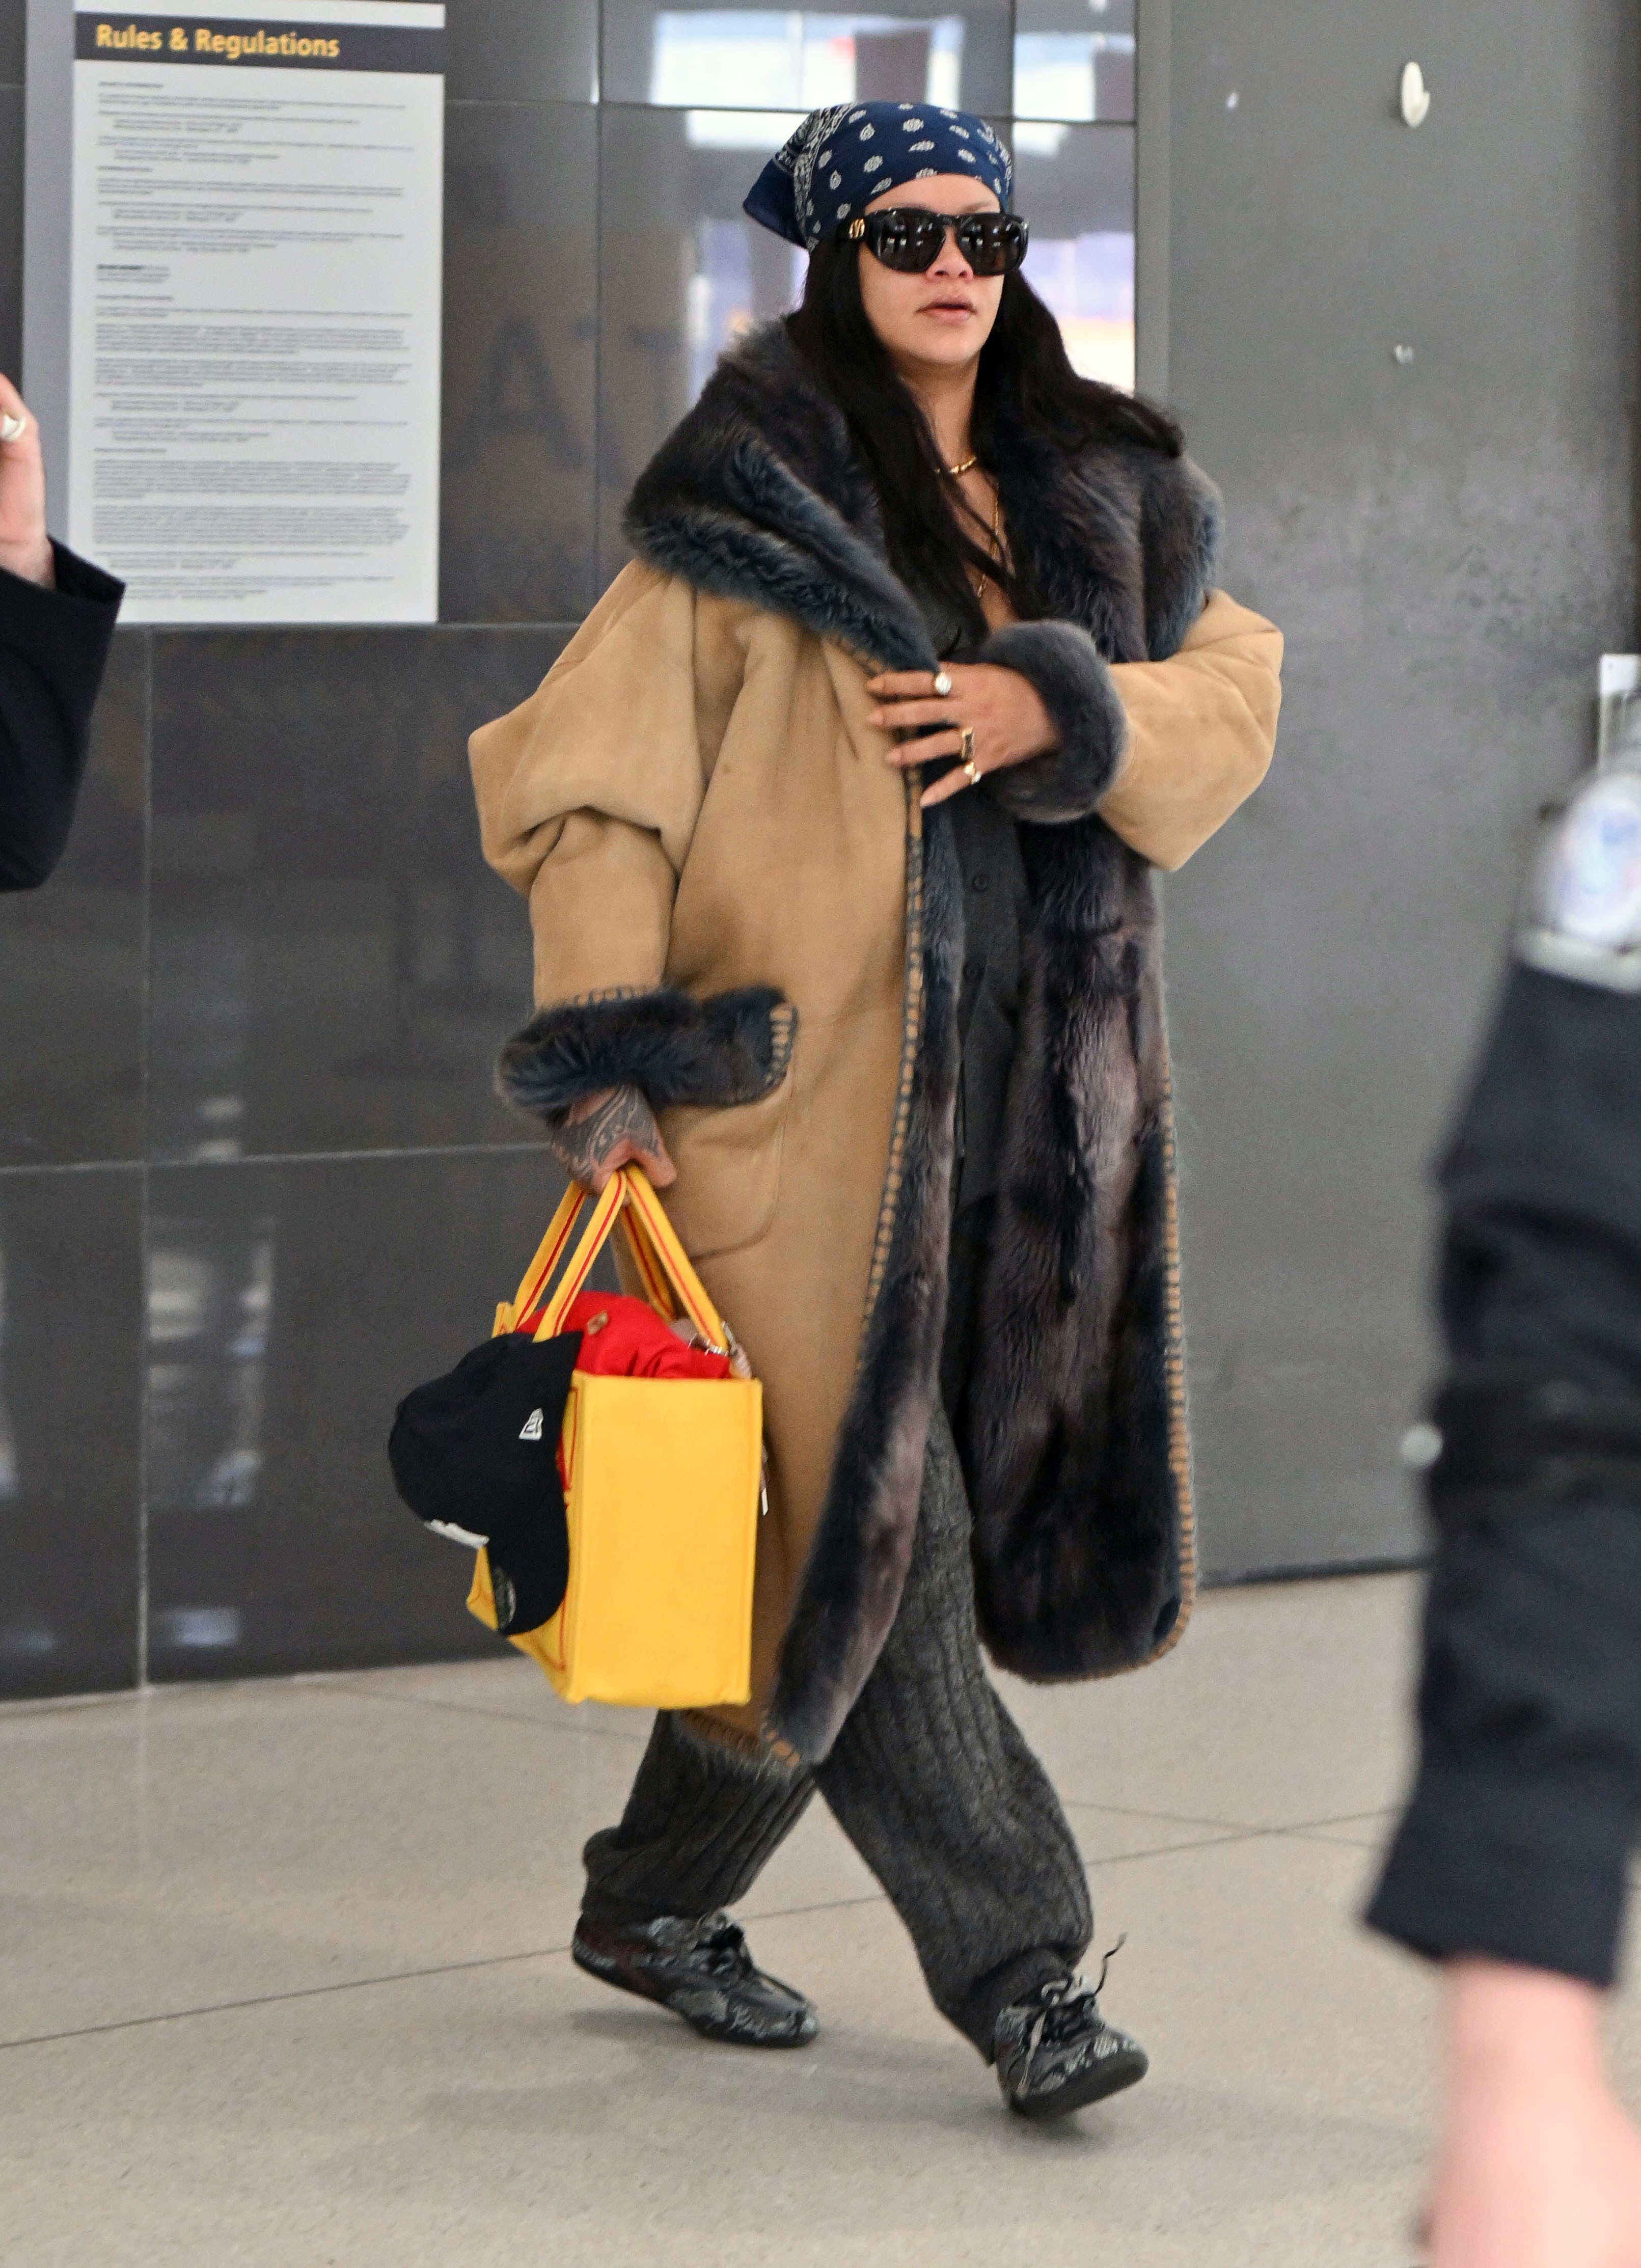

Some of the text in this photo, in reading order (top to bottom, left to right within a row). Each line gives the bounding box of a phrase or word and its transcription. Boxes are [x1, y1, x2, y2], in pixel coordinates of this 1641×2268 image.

[96, 24, 340, 59] Rules & Regulations
